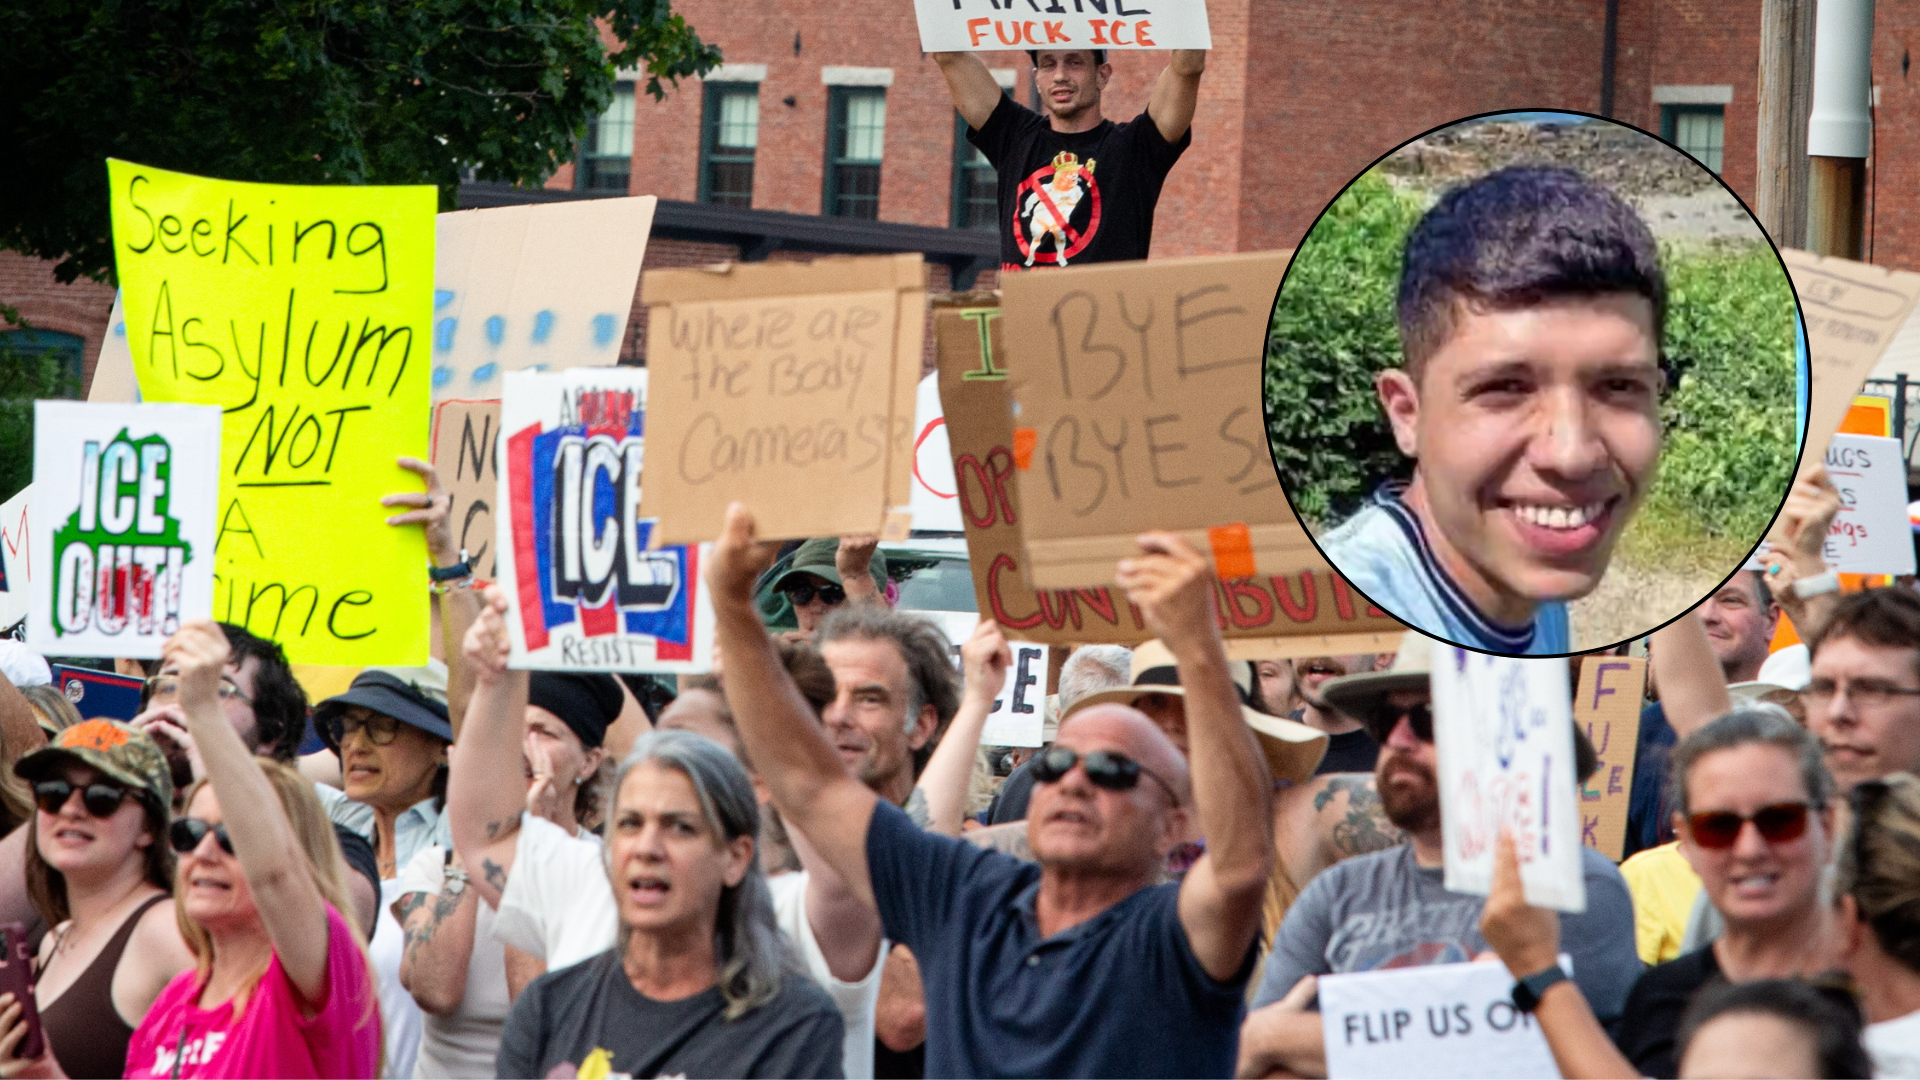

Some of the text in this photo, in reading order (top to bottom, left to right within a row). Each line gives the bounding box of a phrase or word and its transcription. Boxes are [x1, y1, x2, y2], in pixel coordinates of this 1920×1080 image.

[967, 17, 1157, 47] FUCK ICE
[127, 175, 388, 293] Seeking
[150, 279, 413, 414] Asylum
[668, 304, 882, 354] Where are
[1048, 283, 1264, 402] BYE
[683, 345, 868, 412] the Body
[234, 403, 372, 476] NOT
[1044, 413, 1203, 517] BYE
[78, 440, 168, 535] ICE
[213, 497, 265, 559] A
[552, 435, 681, 612] ICE
[56, 540, 185, 636] OUT!
[562, 634, 654, 668] RESIST
[1343, 1010, 1412, 1046] FLIP
[1426, 1002, 1473, 1038] US
